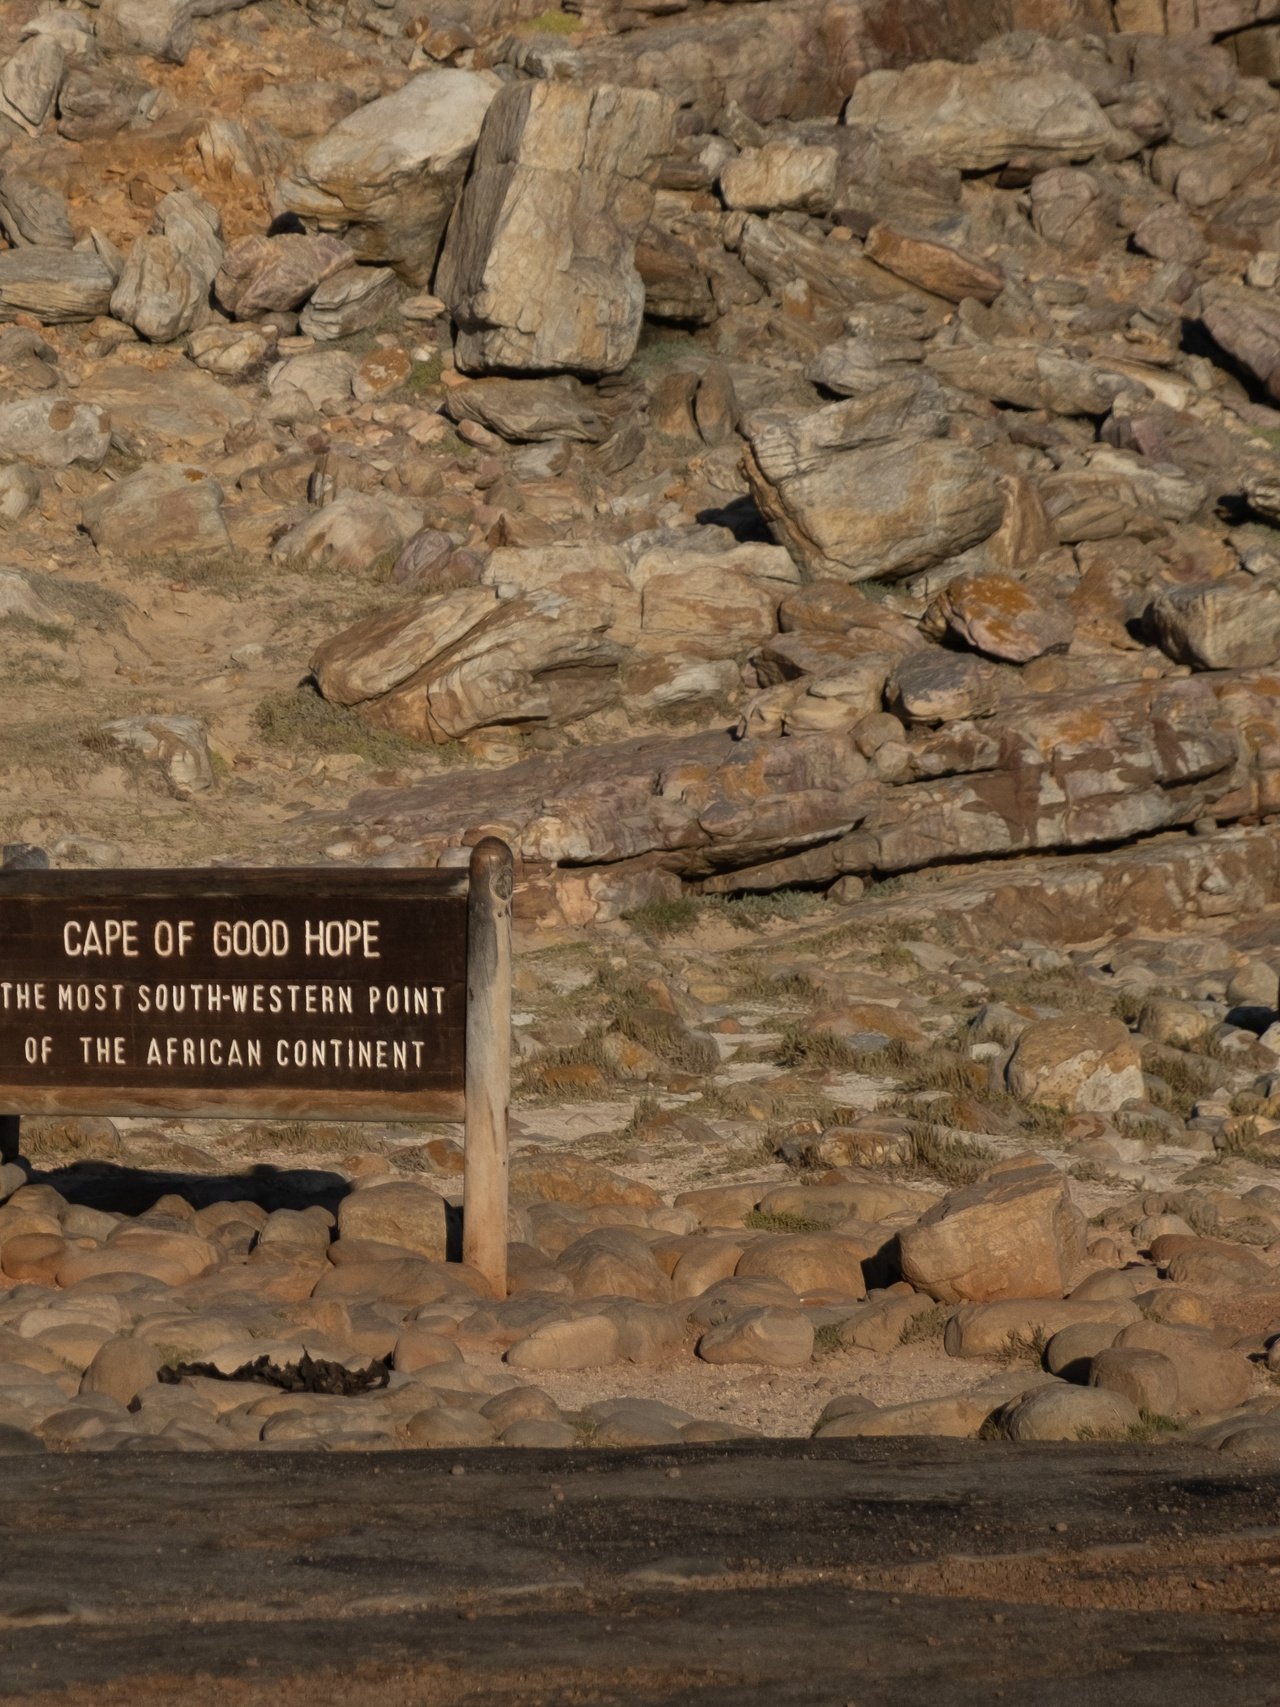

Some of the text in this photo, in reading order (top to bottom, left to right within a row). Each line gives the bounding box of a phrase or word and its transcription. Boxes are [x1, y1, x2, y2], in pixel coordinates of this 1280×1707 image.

[63, 919, 381, 958] CAPE OF GOOD HOPE
[0, 982, 445, 1015] THE MOST SOUTH-WESTERN POINT
[24, 1036, 425, 1070] OF THE AFRICAN CONTINENT
